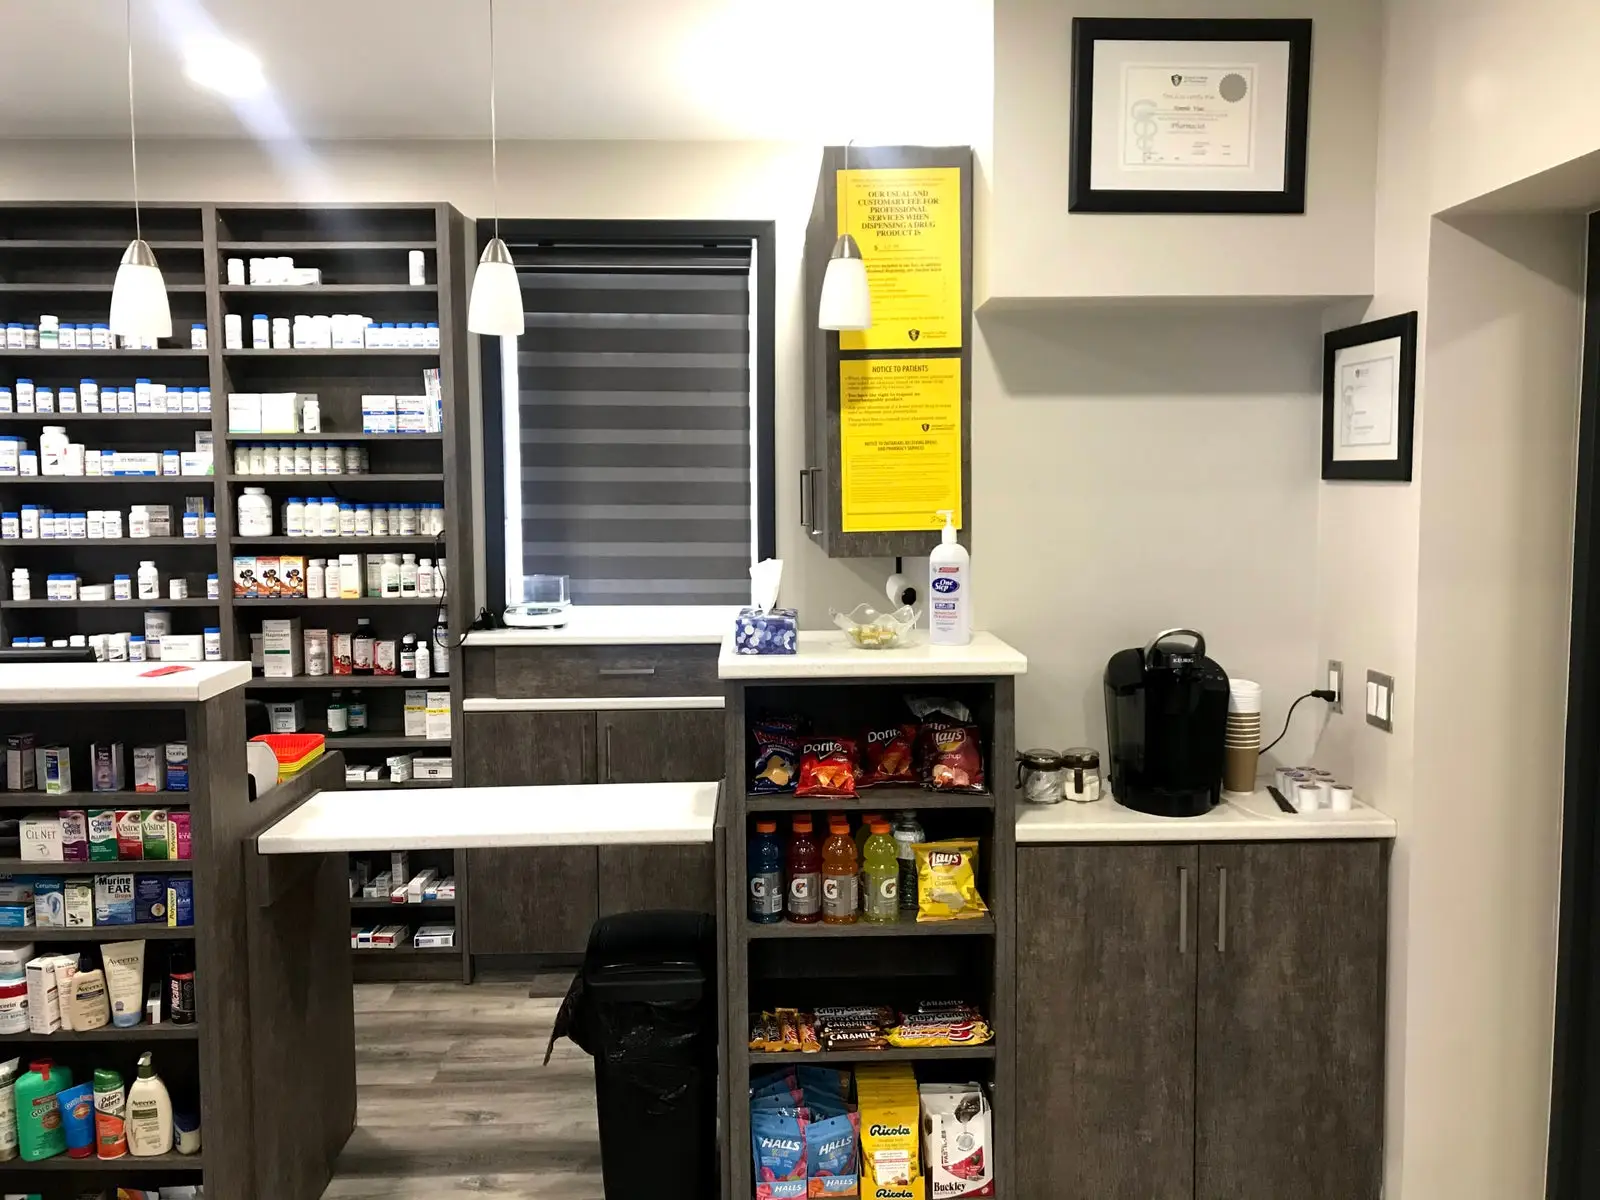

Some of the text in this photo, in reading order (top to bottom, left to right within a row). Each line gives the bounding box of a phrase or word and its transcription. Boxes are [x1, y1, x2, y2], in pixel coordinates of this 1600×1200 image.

[858, 198, 905, 206] CUSTOMARY
[872, 365, 893, 373] NOTICE
[902, 364, 929, 372] PATIENTS
[935, 583, 949, 592] Step
[803, 741, 848, 754] Dorito
[62, 821, 81, 829] Clear
[91, 820, 112, 828] Clear
[117, 823, 139, 832] Visine
[142, 822, 164, 831] Visine
[64, 827, 82, 836] eyes
[93, 825, 113, 833] eyes
[98, 876, 131, 886] Murine
[108, 885, 131, 894] EAR
[751, 877, 765, 898] G
[791, 878, 808, 898] G
[823, 879, 838, 899] G
[880, 878, 897, 899] G
[107, 956, 139, 966] Aveeno
[76, 983, 103, 993] Aveeno
[827, 1020, 873, 1028] CARAMILK
[829, 1032, 876, 1040] CARAMILK
[30, 1104, 50, 1118] GOLD
[870, 1124, 911, 1137] Ricola
[761, 1138, 801, 1151] HALLS
[819, 1136, 853, 1155] HALLS
[825, 1178, 854, 1187] HALLS
[934, 1182, 966, 1192] Buckley
[774, 1184, 802, 1193] HALLS
[876, 1188, 913, 1198] Ricola
